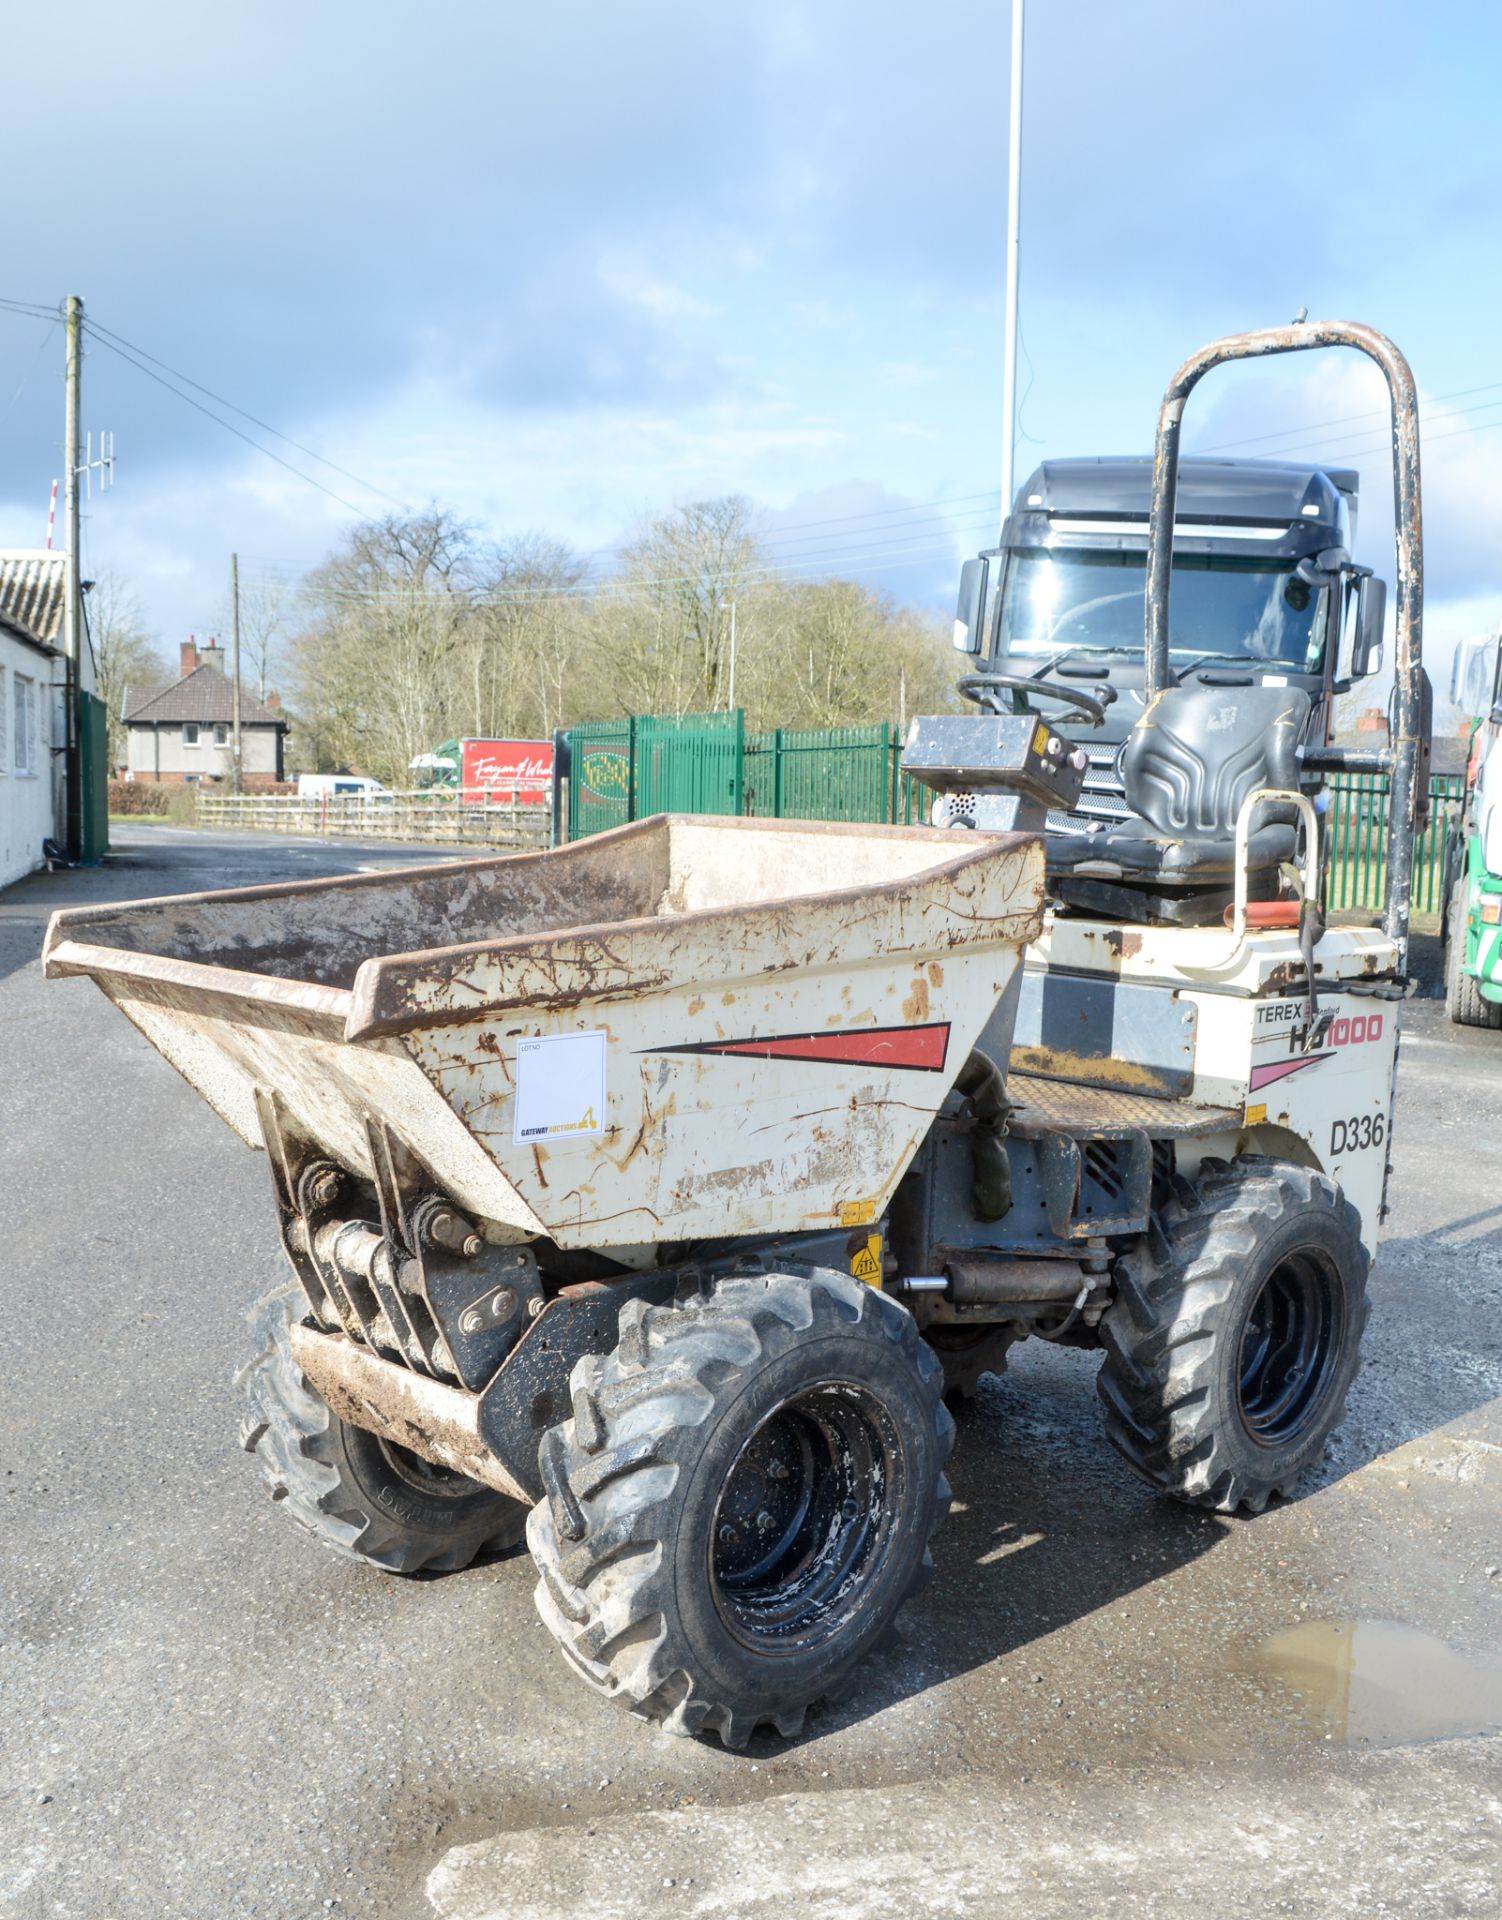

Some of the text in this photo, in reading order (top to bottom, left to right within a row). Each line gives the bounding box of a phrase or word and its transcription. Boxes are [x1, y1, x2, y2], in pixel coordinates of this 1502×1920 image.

[525, 758, 553, 777] Whal
[1257, 1003, 1303, 1024] TEREX
[521, 1126, 549, 1137] GATEWAY
[1330, 1113, 1385, 1157] D336
